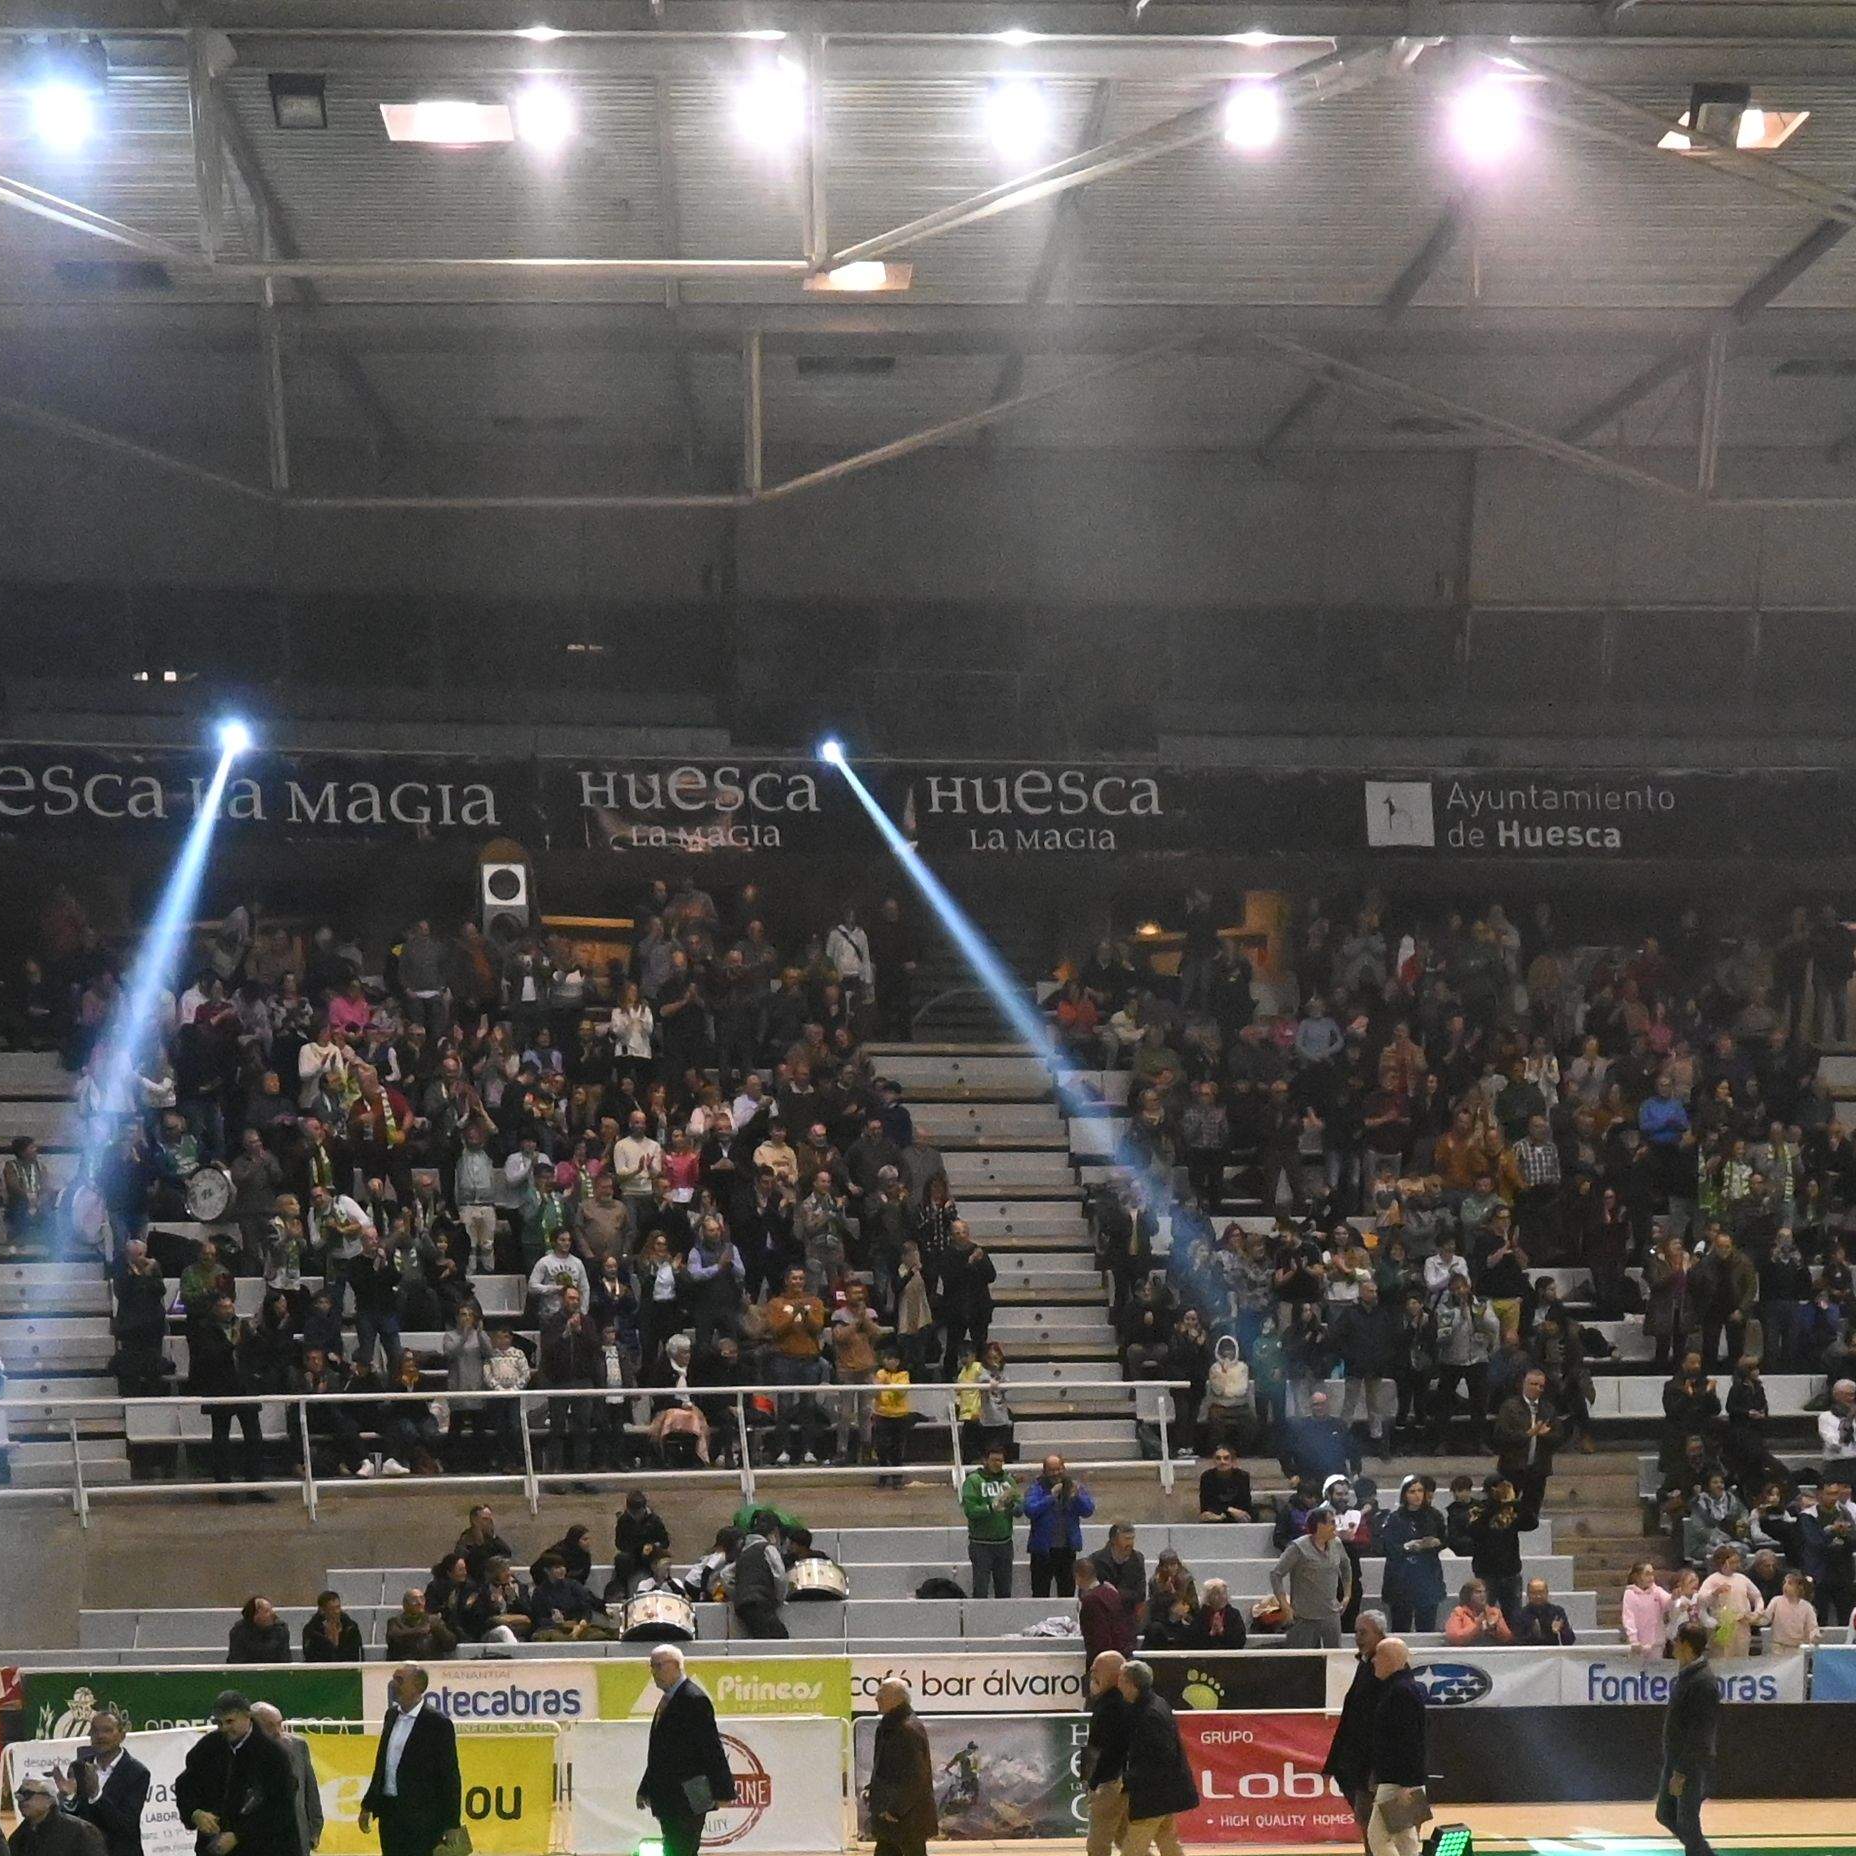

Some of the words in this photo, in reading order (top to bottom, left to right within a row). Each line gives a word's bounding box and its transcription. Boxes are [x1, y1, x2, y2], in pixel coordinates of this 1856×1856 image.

[1447, 781, 1676, 815] Ayuntamiento
[1448, 821, 1486, 850] de
[1497, 819, 1623, 850] Huesca
[921, 1669, 975, 1698] bar
[983, 1668, 1082, 1698] álvaro
[388, 1679, 582, 1719] ntecabras
[1200, 1730, 1254, 1745] GRUPO
[1220, 1813, 1250, 1827] HIGH
[1255, 1813, 1307, 1829] QUALITY
[1312, 1812, 1356, 1826] HOMES
